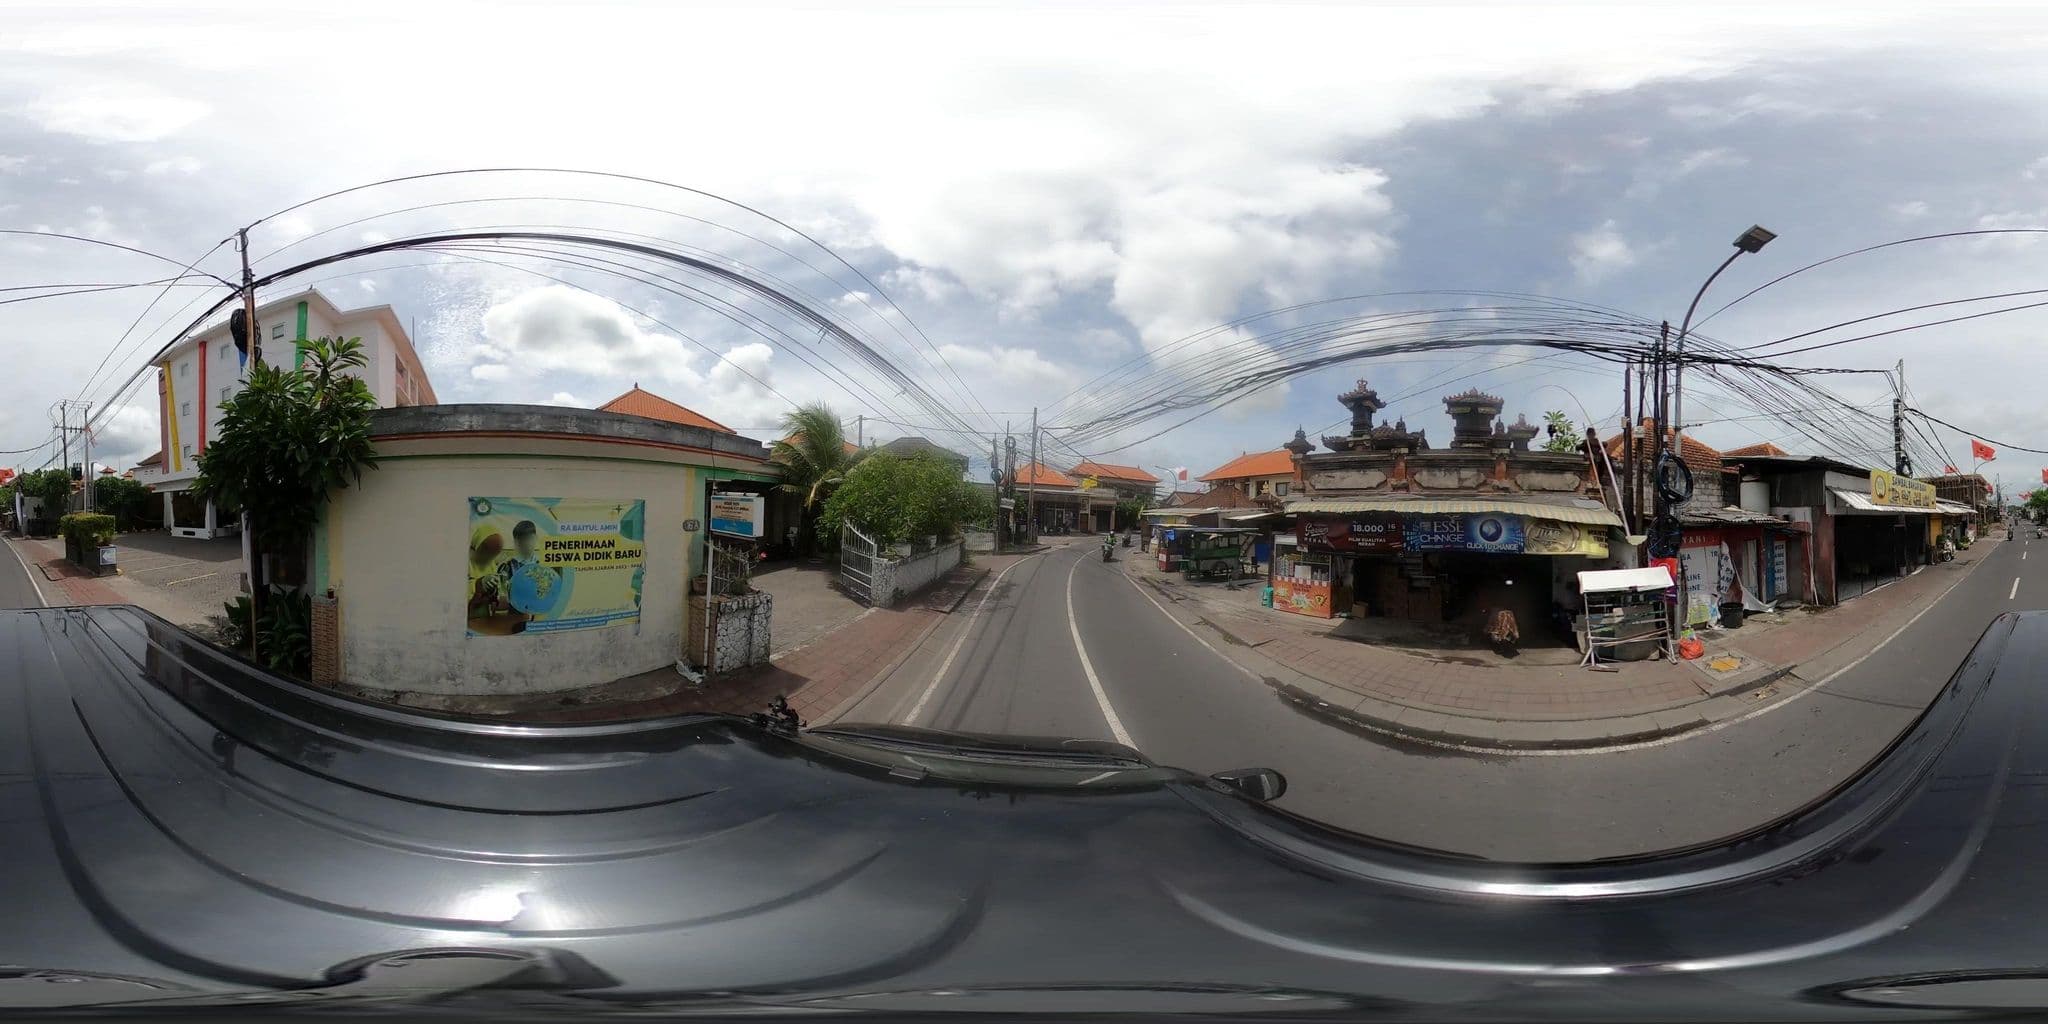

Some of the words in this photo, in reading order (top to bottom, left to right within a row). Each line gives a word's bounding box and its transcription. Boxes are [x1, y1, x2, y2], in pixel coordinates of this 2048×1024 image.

[560, 524, 572, 532] RA
[572, 524, 598, 532] BAITUL
[600, 523, 618, 531] AMIN
[1353, 524, 1384, 533] 18.000
[1433, 520, 1464, 533] ESSE
[1420, 534, 1464, 543] CHANGE
[544, 539, 615, 551] PENERIMAAN
[1493, 543, 1519, 551] CHANGE
[544, 552, 581, 563] SISWA
[583, 551, 613, 561] DIDIK
[614, 549, 642, 560] BARU
